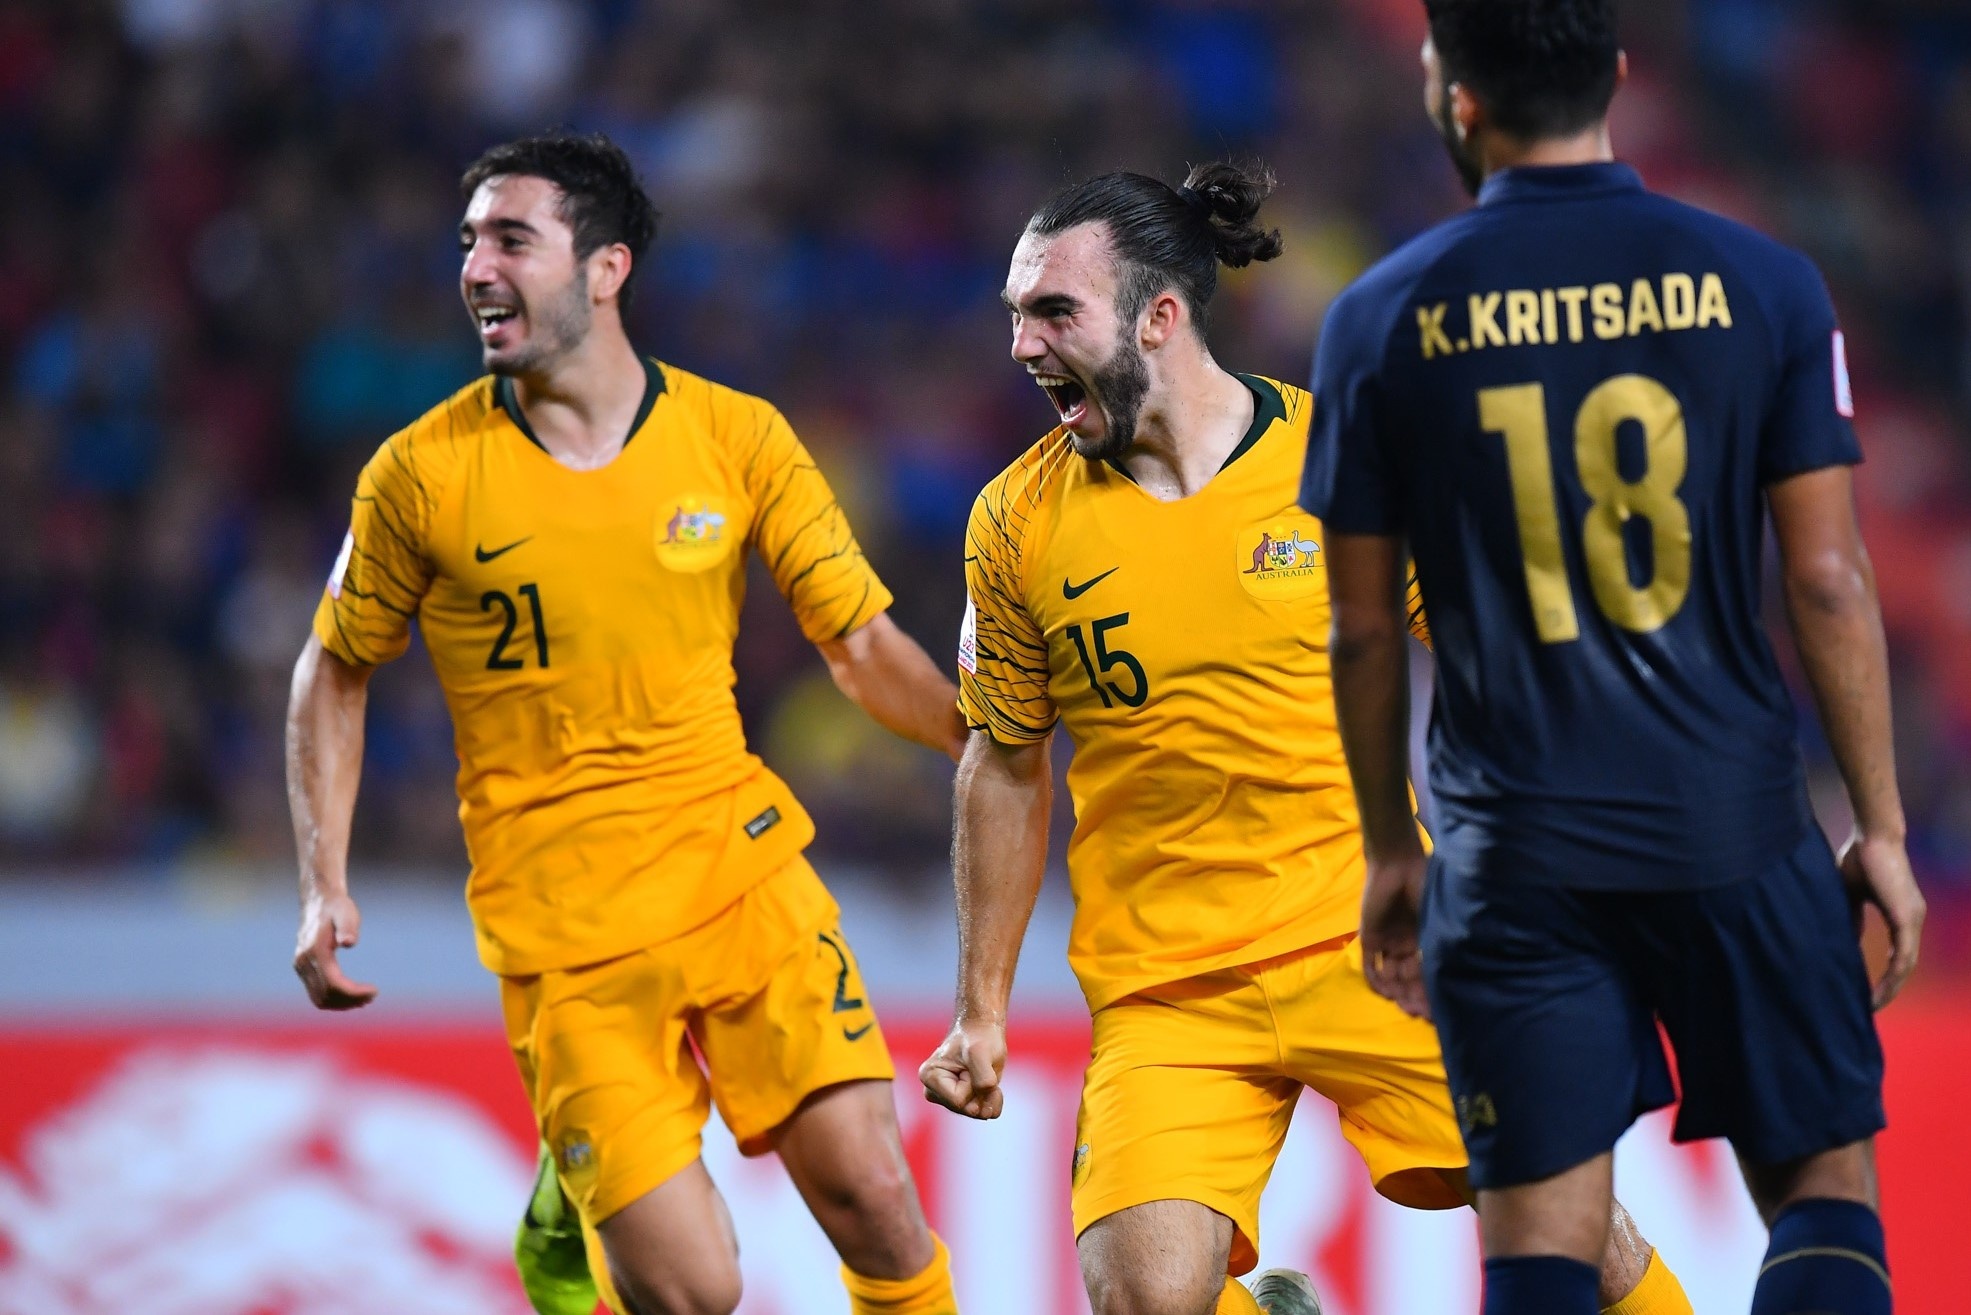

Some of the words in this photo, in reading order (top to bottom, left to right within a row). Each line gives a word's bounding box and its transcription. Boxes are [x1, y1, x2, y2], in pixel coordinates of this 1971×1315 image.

[1416, 272, 1733, 359] K.KRITSADA
[1477, 373, 1692, 643] 18
[1256, 568, 1314, 580] AUSTRALIA
[480, 583, 549, 670] 21
[1065, 611, 1148, 709] 15
[818, 930, 863, 1013] 2
